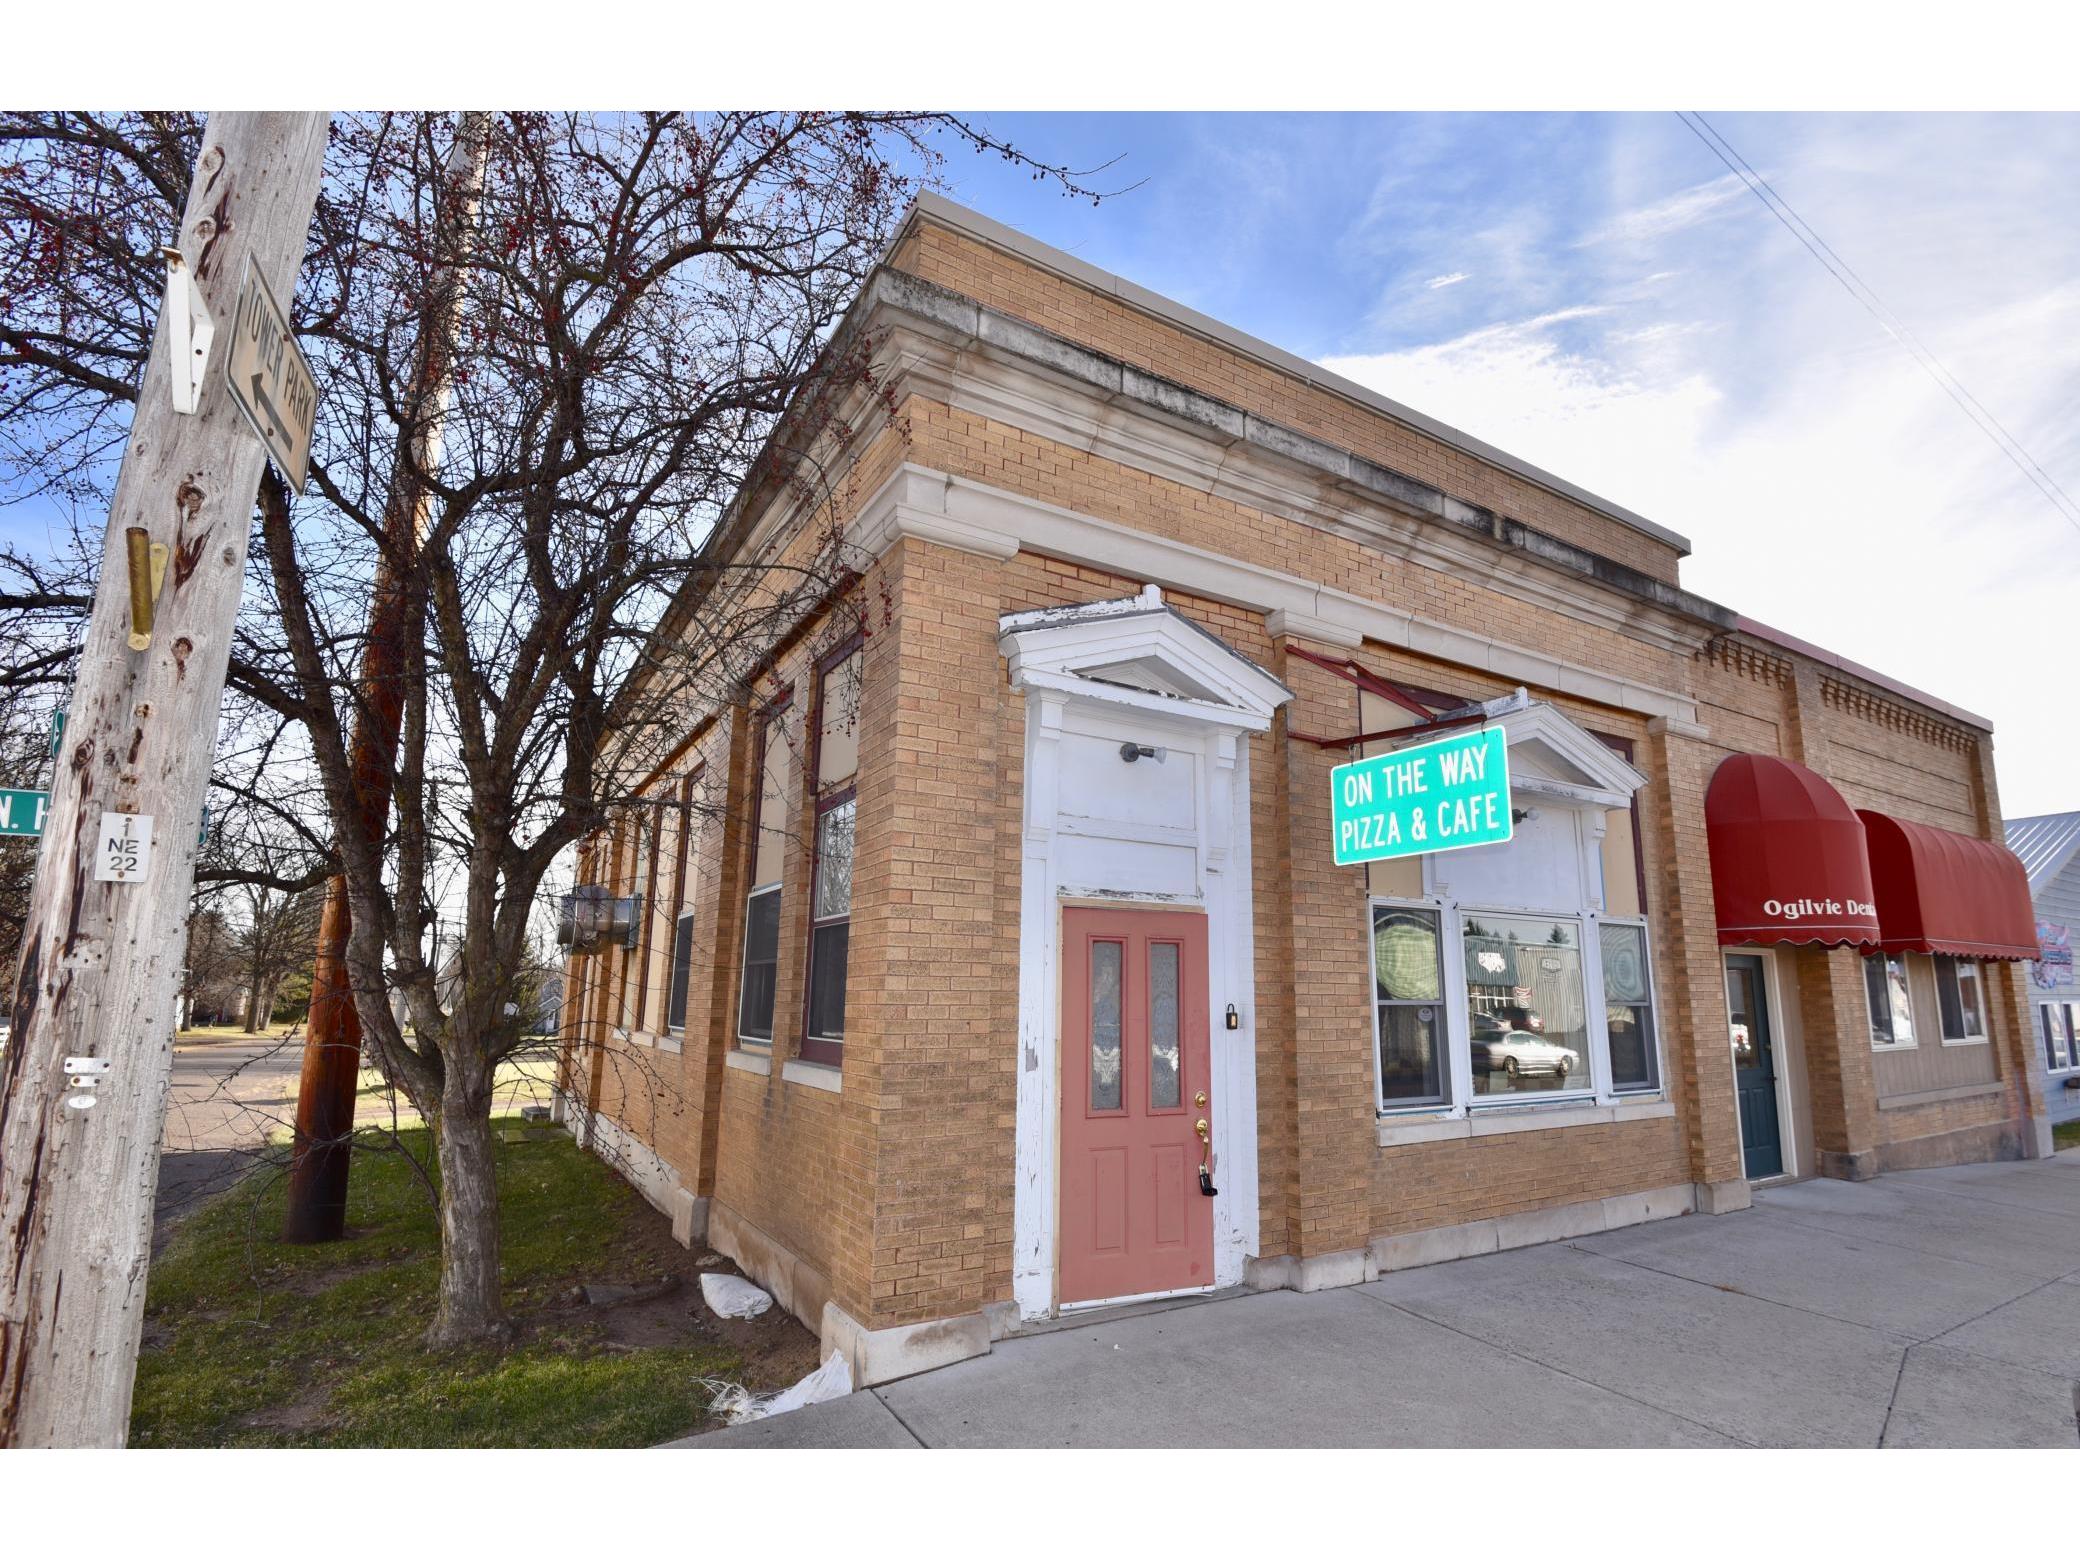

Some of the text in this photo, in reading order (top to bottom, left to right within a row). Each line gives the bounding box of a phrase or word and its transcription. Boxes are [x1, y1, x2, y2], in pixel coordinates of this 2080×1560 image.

[246, 278, 313, 436] TOWER PARK
[1344, 743, 1489, 807] ON THE WAY
[1341, 792, 1500, 853] PIZZA & CAFE
[108, 838, 139, 854] NE
[109, 856, 137, 872] 22
[1763, 898, 1842, 919] Ogilvie
